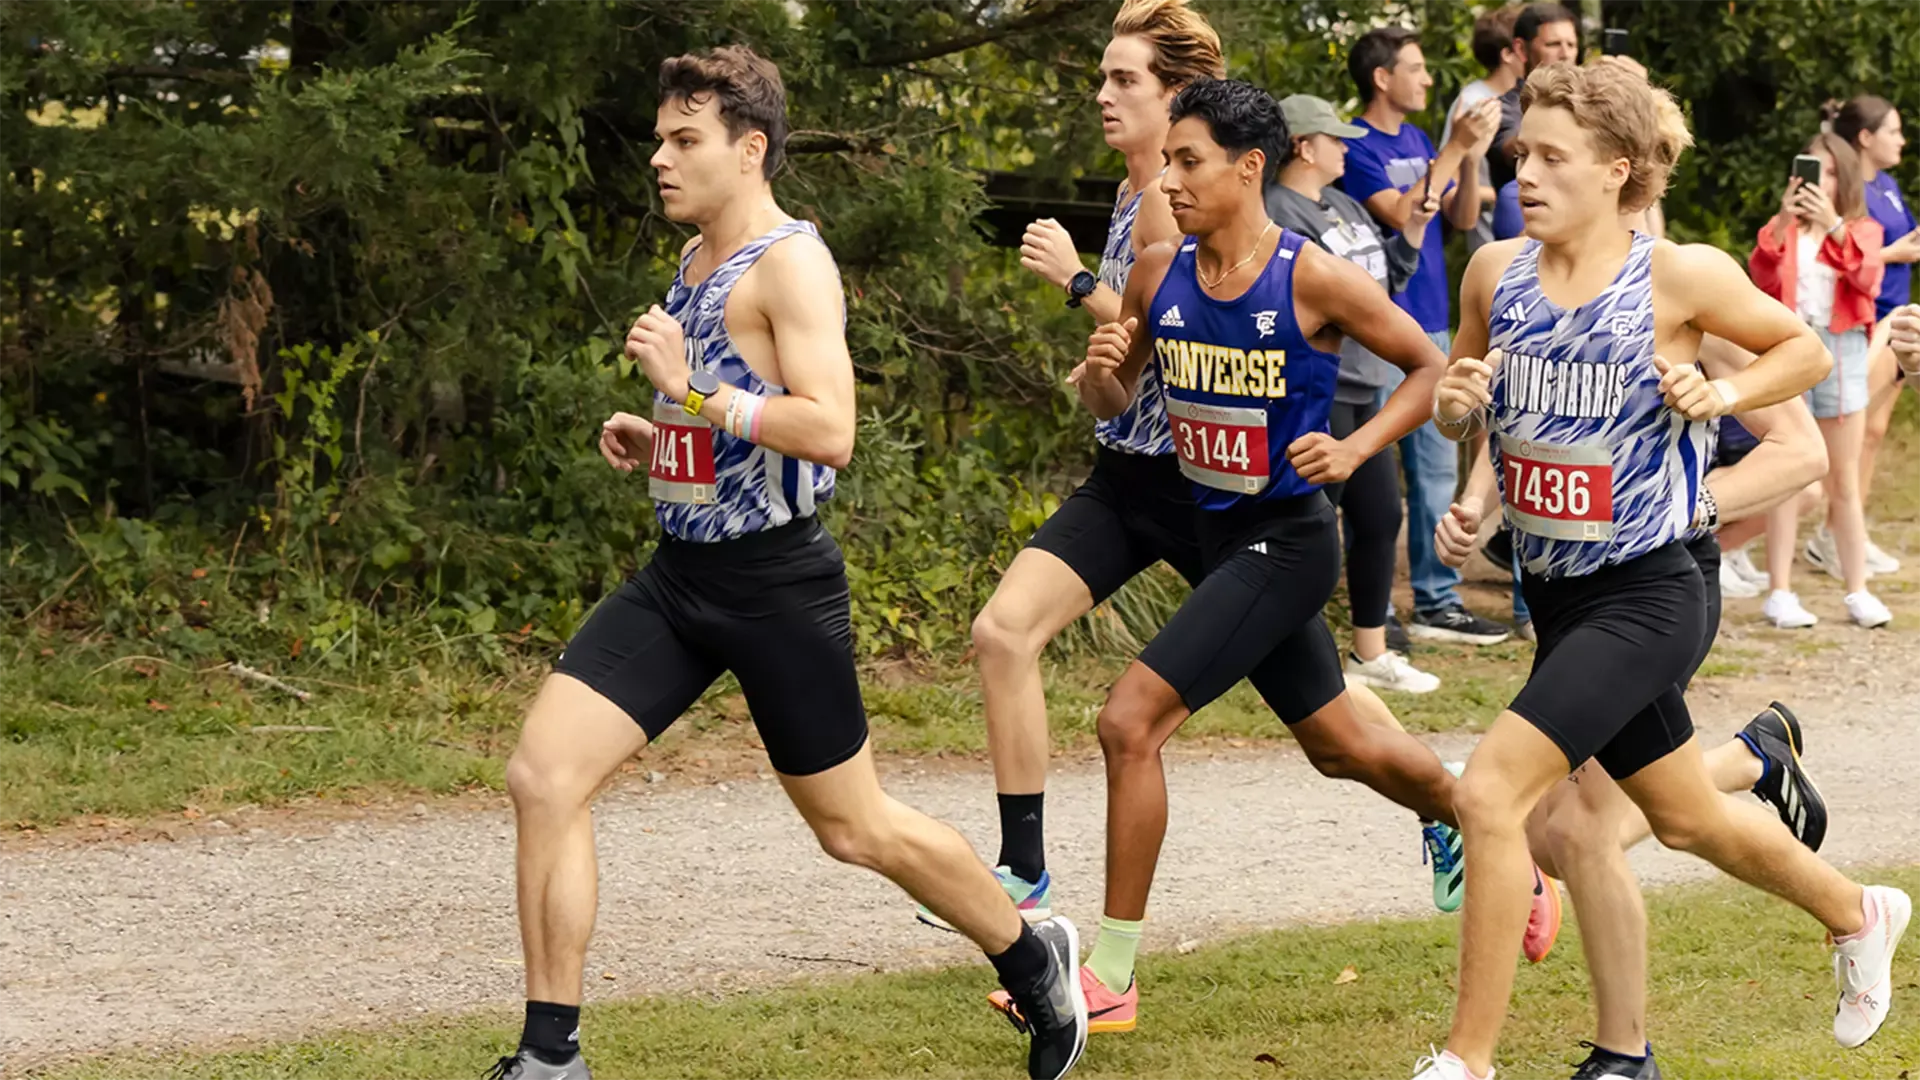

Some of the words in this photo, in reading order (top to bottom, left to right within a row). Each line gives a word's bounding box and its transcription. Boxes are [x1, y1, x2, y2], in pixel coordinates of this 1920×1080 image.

[1155, 337, 1287, 398] CONVERSE
[1554, 359, 1628, 419] HARRIS
[1178, 420, 1250, 471] 3144
[1508, 460, 1591, 517] 7436
